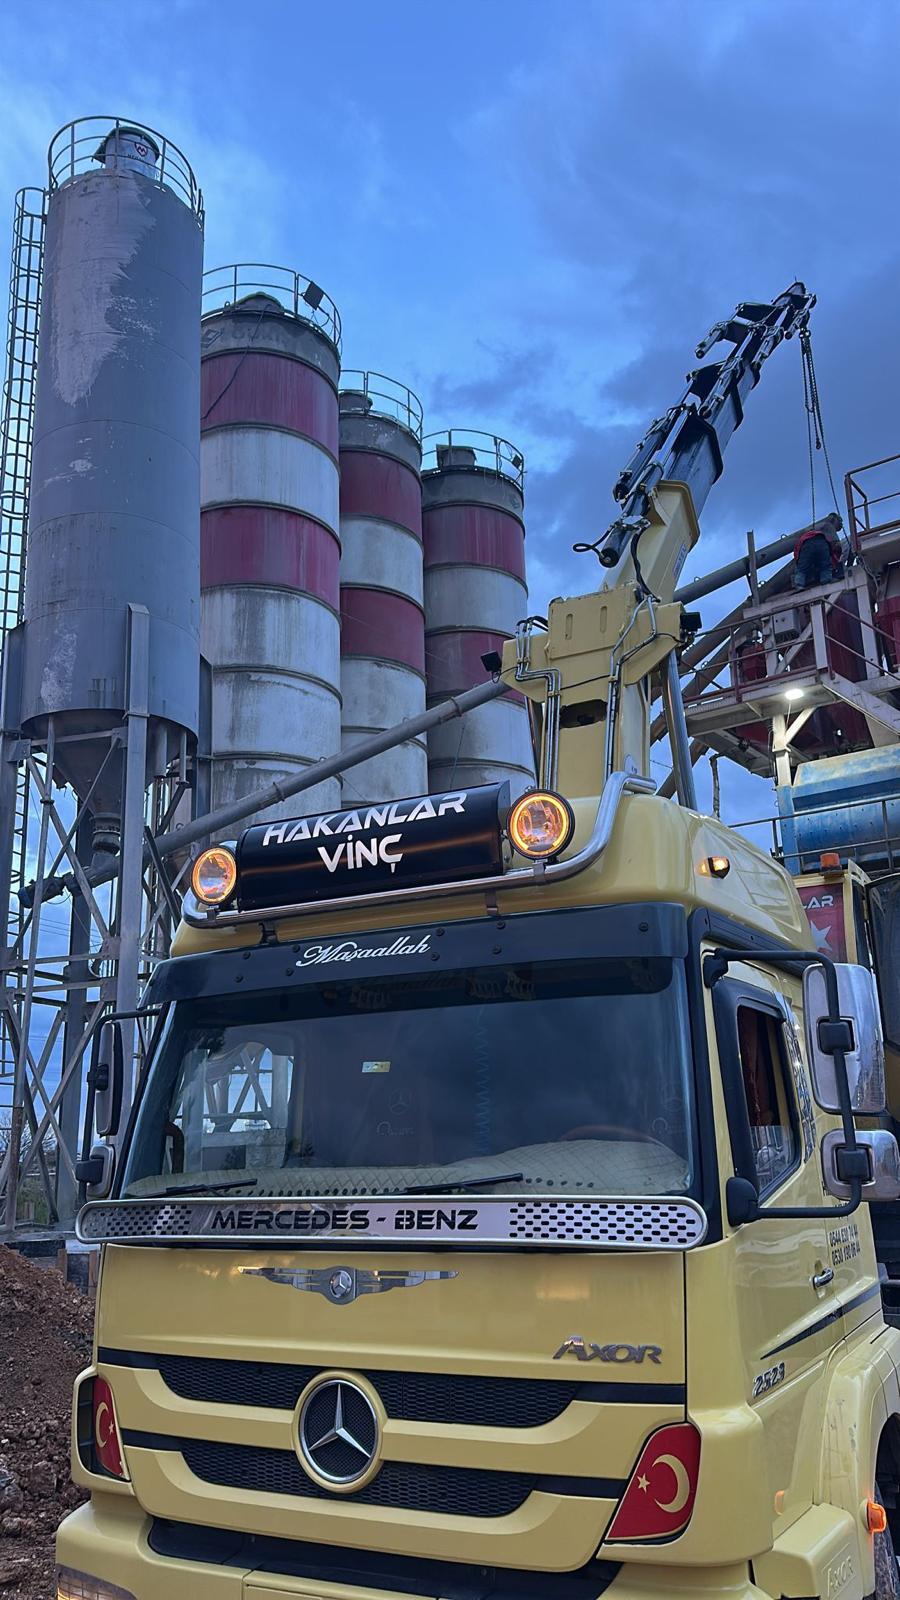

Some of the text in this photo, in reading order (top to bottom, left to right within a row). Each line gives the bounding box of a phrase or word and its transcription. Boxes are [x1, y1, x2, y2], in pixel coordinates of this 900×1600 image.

[262, 792, 468, 846] HAKANLAR
[317, 832, 404, 874] VİNÇ
[295, 933, 432, 968] Maşaallah
[211, 1209, 370, 1231] MERCEDES
[394, 1209, 479, 1231] BENZ
